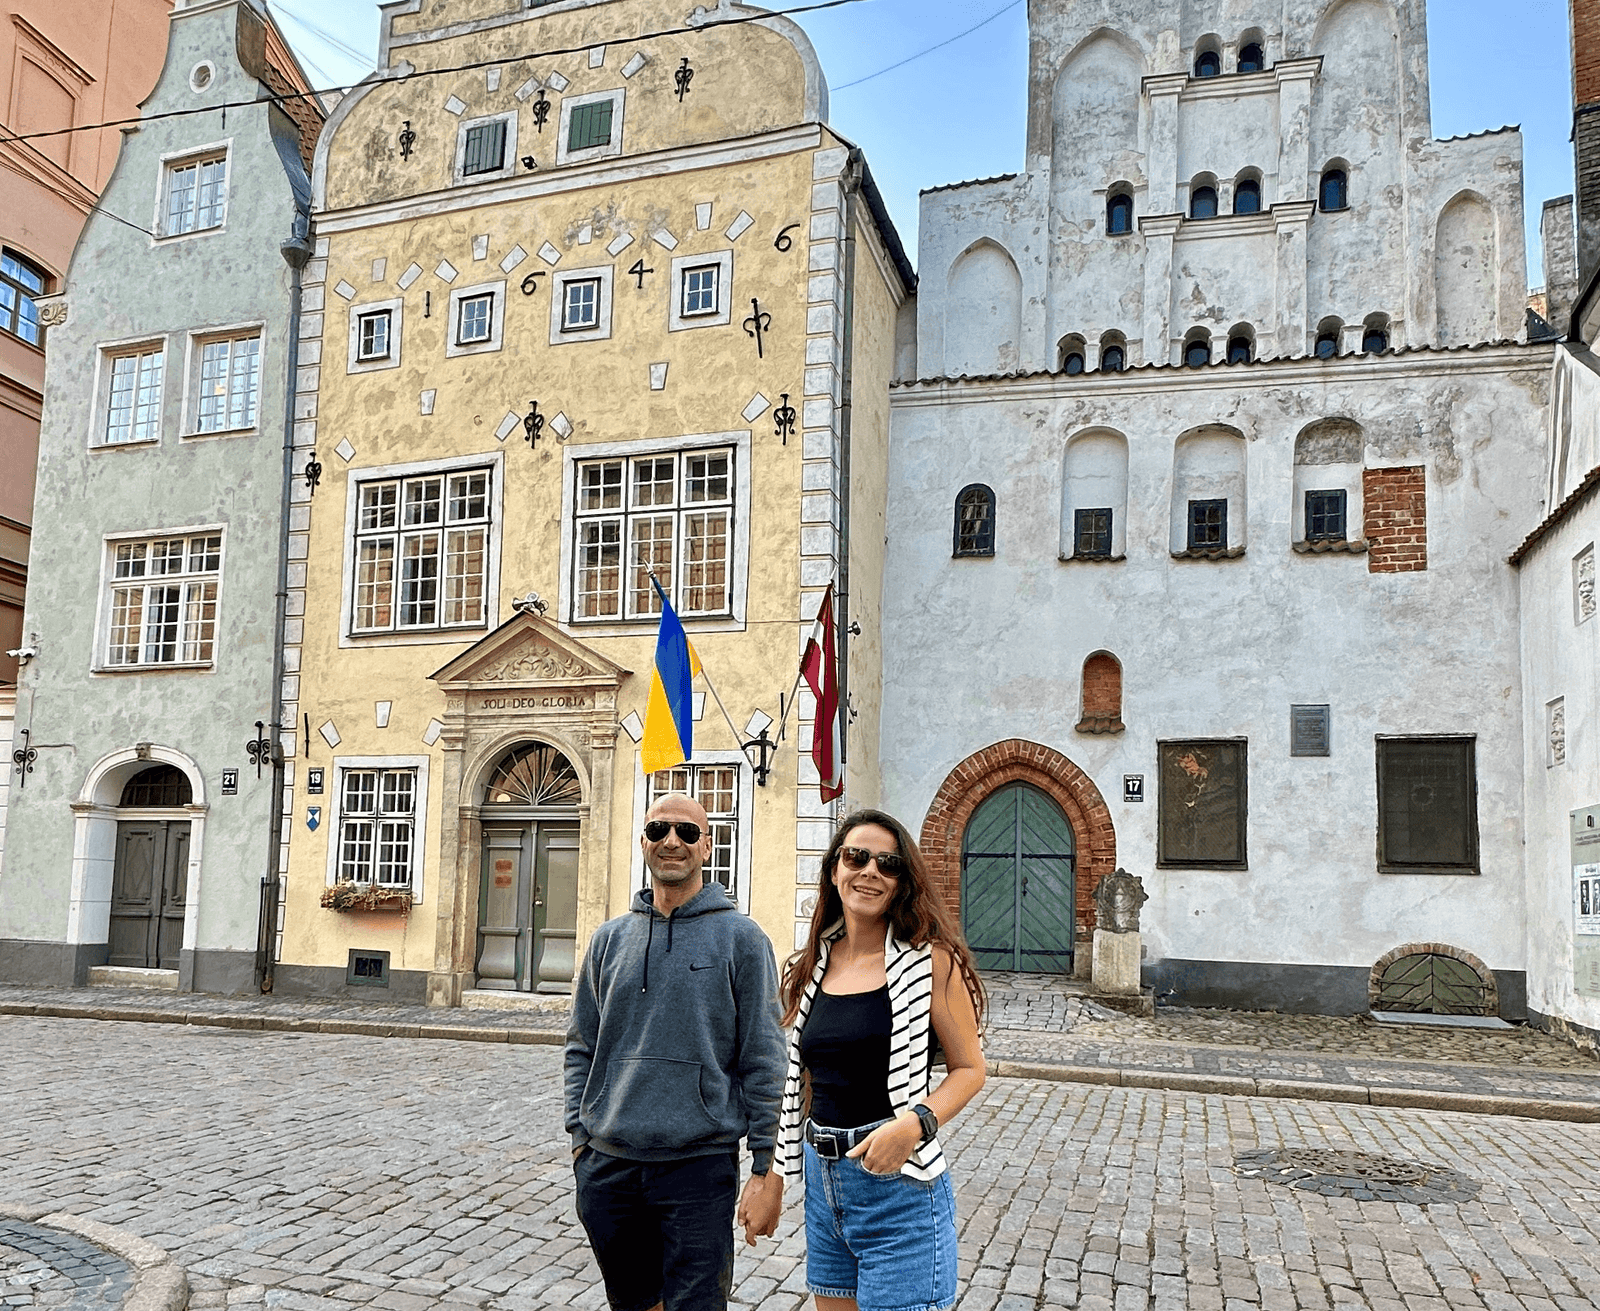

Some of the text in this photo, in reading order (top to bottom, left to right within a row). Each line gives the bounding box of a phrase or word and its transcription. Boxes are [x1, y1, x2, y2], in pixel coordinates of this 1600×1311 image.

[520, 271, 546, 296] 6
[628, 259, 654, 289] 4
[774, 223, 801, 252] 6
[481, 698, 506, 710] SOLI
[512, 697, 536, 709] DEO
[542, 696, 586, 708] GLORIA
[224, 774, 235, 785] 21
[310, 772, 321, 784] 19
[1127, 780, 1140, 792] 17
